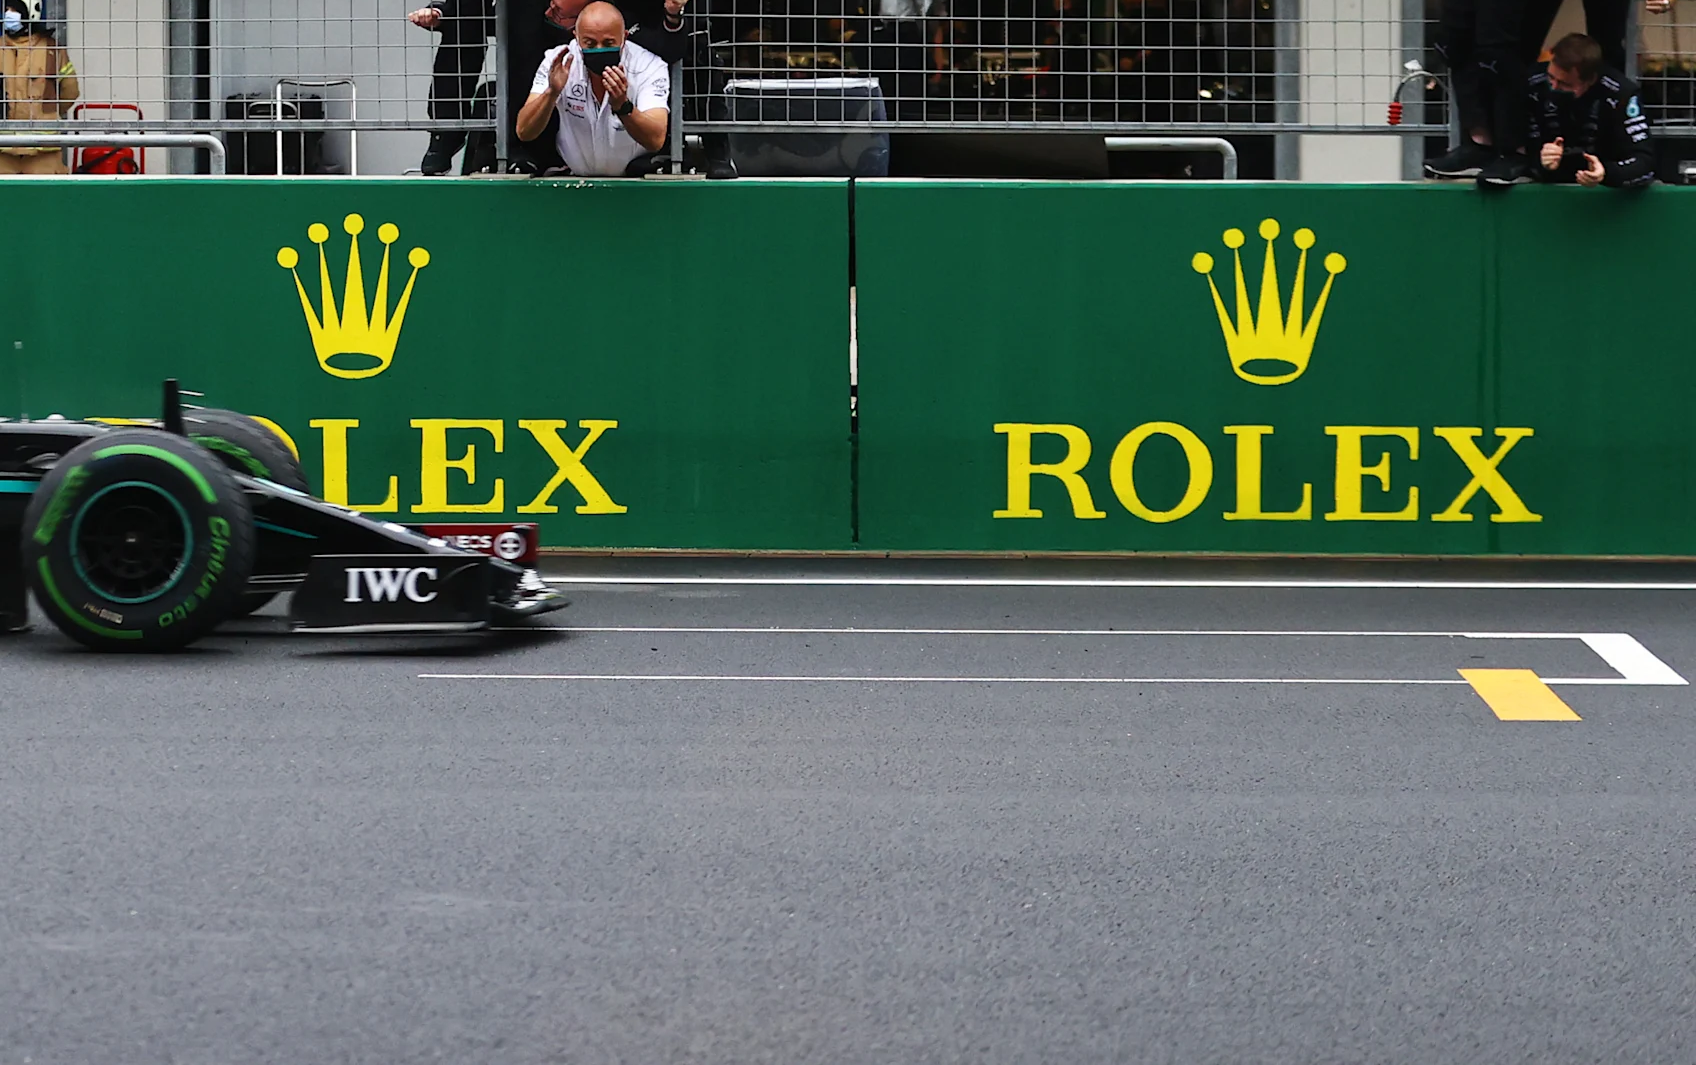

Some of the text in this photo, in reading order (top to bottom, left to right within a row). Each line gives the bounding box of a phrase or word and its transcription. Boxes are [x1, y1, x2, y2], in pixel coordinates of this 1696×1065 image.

[993, 421, 1543, 522] ROLEX
[159, 516, 231, 628] Cinturato
[343, 567, 438, 602] IWC
